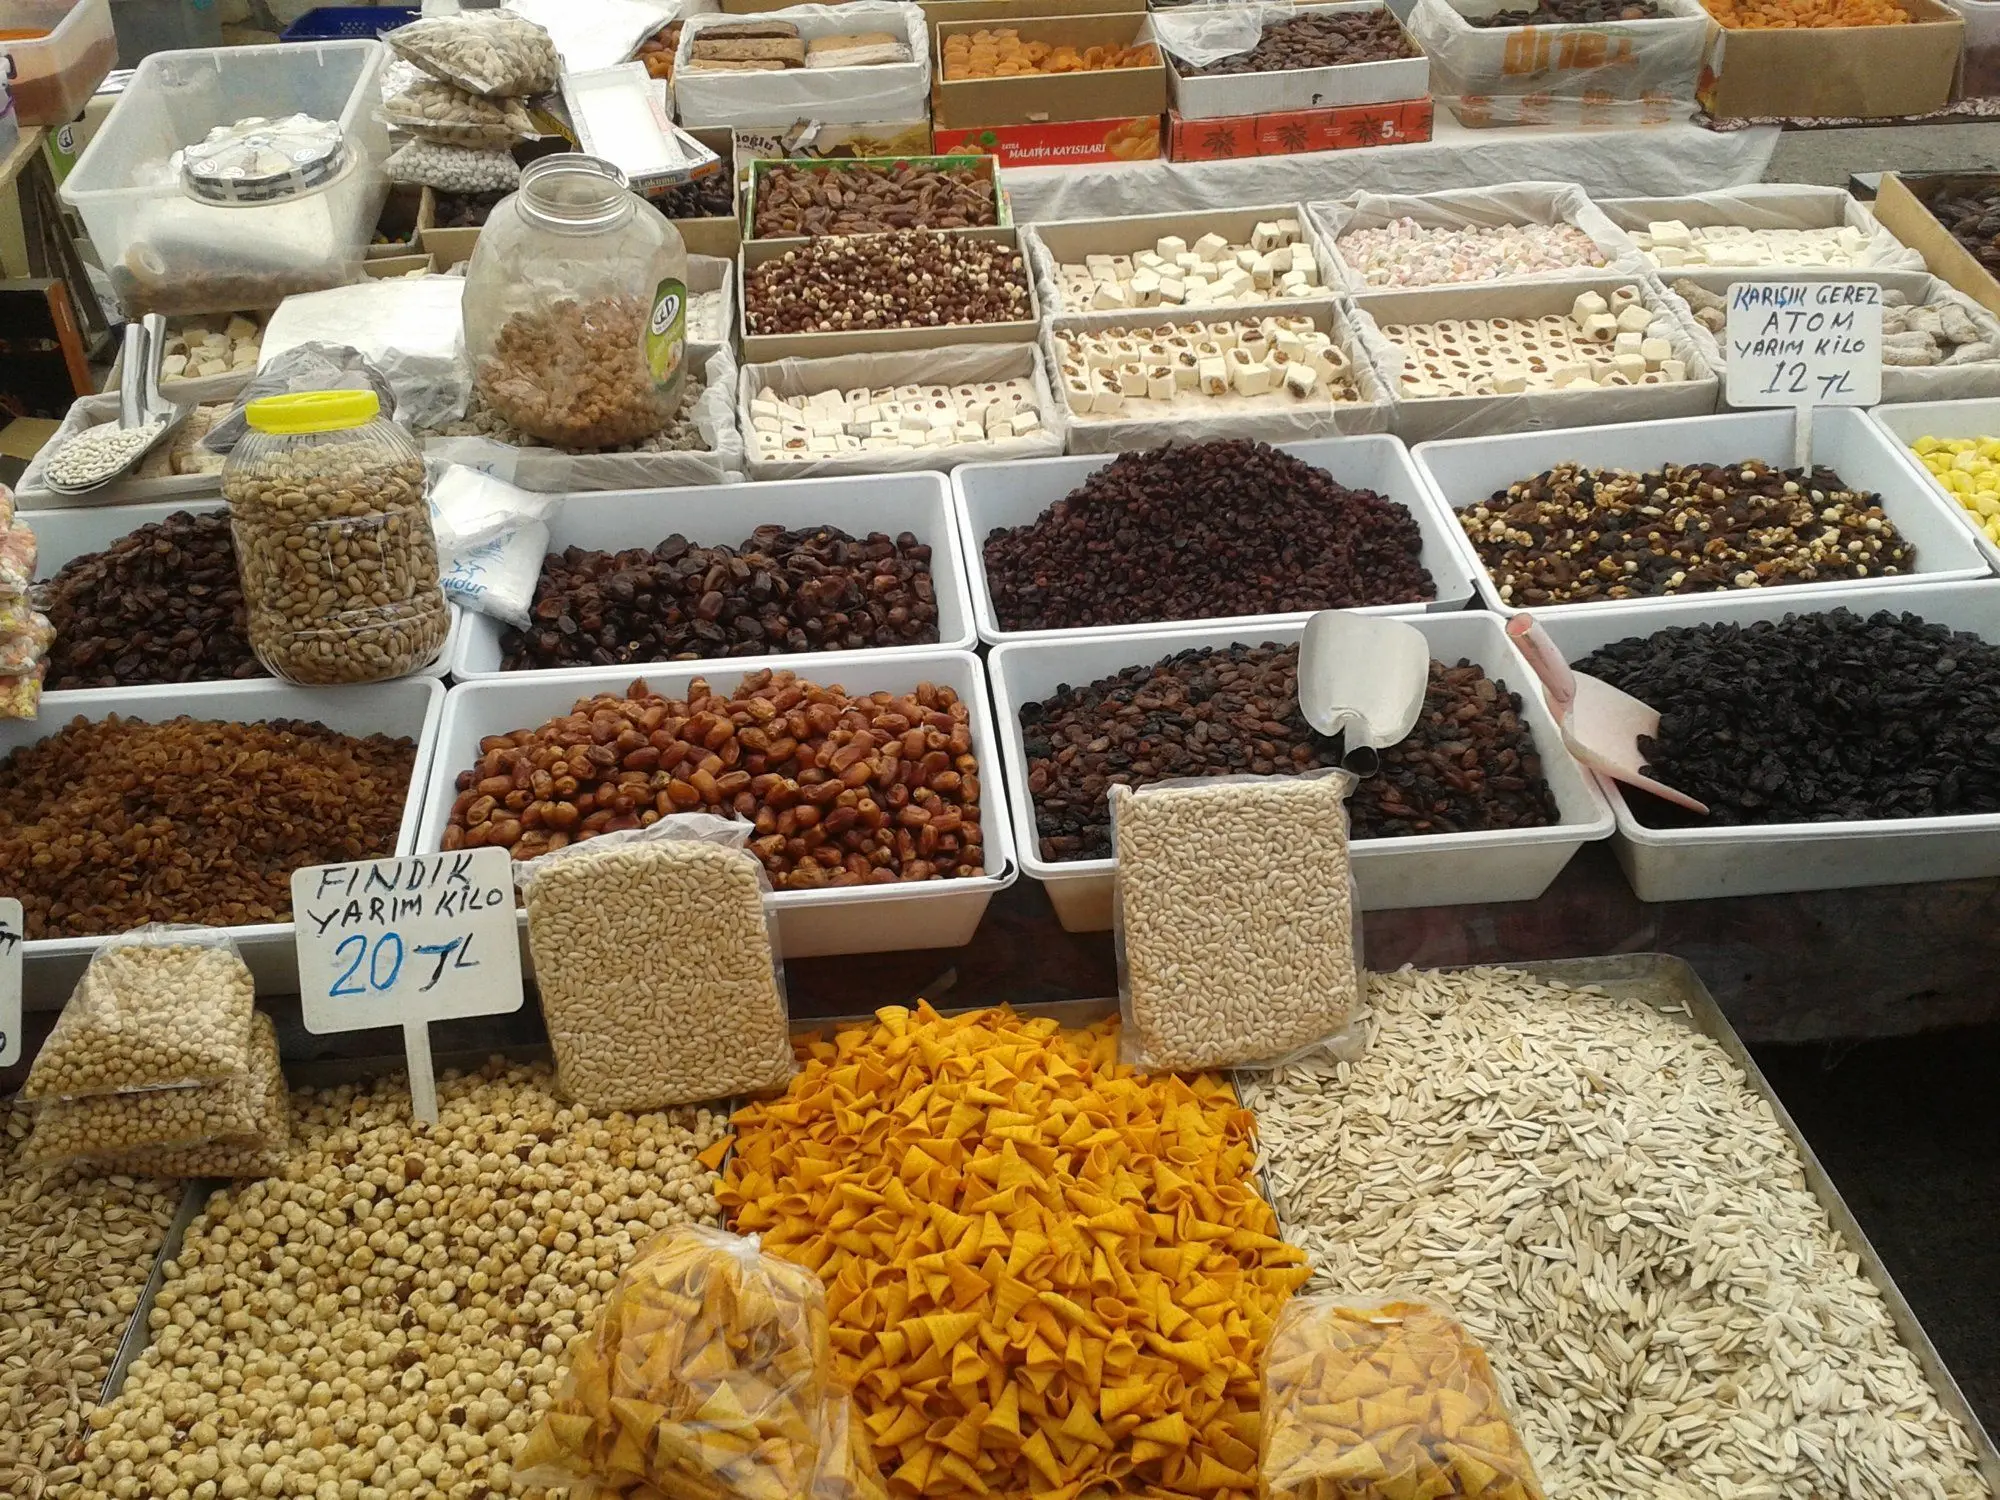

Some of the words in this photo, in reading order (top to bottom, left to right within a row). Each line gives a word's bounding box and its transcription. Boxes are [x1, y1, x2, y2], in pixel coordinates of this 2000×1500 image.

[1381, 120, 1394, 138] 5
[736, 132, 774, 151] oğlu
[1009, 145, 1050, 158] MALATYA
[1052, 143, 1106, 157] KAYISILARI
[1761, 311, 1854, 335] ATOM
[1734, 338, 1804, 358] YARIM
[1760, 360, 1808, 393] 12
[1817, 370, 1855, 400] TL
[316, 853, 473, 899] FINDIK
[306, 893, 422, 935] YARIM
[328, 931, 403, 997] 20
[412, 932, 481, 992] TL
